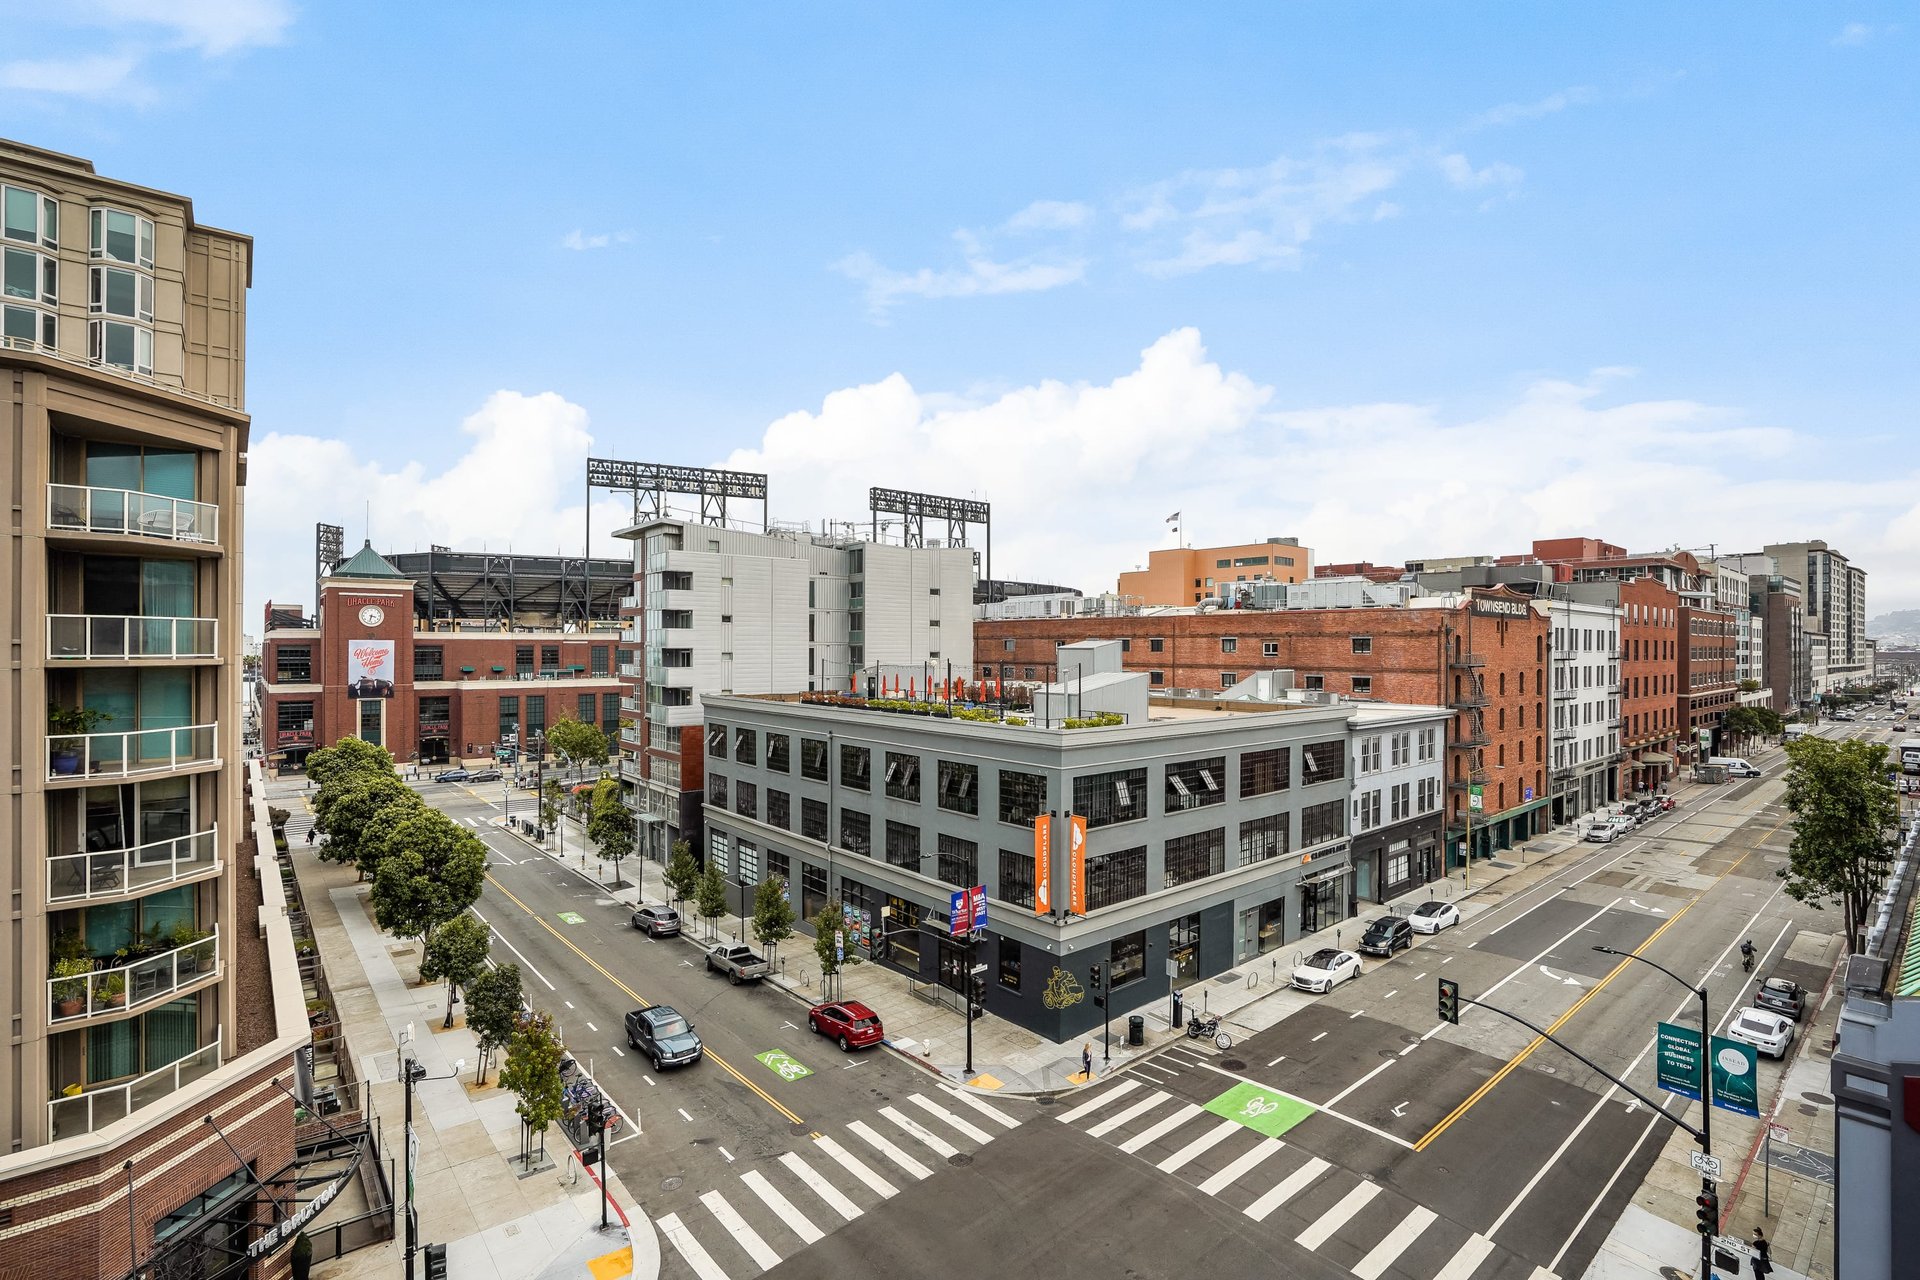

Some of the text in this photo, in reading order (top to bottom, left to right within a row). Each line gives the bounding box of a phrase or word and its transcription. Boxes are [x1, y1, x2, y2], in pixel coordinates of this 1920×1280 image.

[347, 597, 396, 608] ORACLE PARK
[1476, 599, 1510, 613] TOWNSEND
[353, 647, 389, 659] Welcome
[361, 656, 384, 668] Home
[1660, 1033, 1699, 1048] CONNECTING
[1667, 1044, 1691, 1053] GLOBAL
[1664, 1051, 1694, 1062] BUSINESS
[1722, 1056, 1745, 1066] INSEAD
[1676, 1062, 1692, 1070] TECH
[248, 1181, 337, 1257] THE BRIXTON
[1721, 1239, 1736, 1247] 2ND
